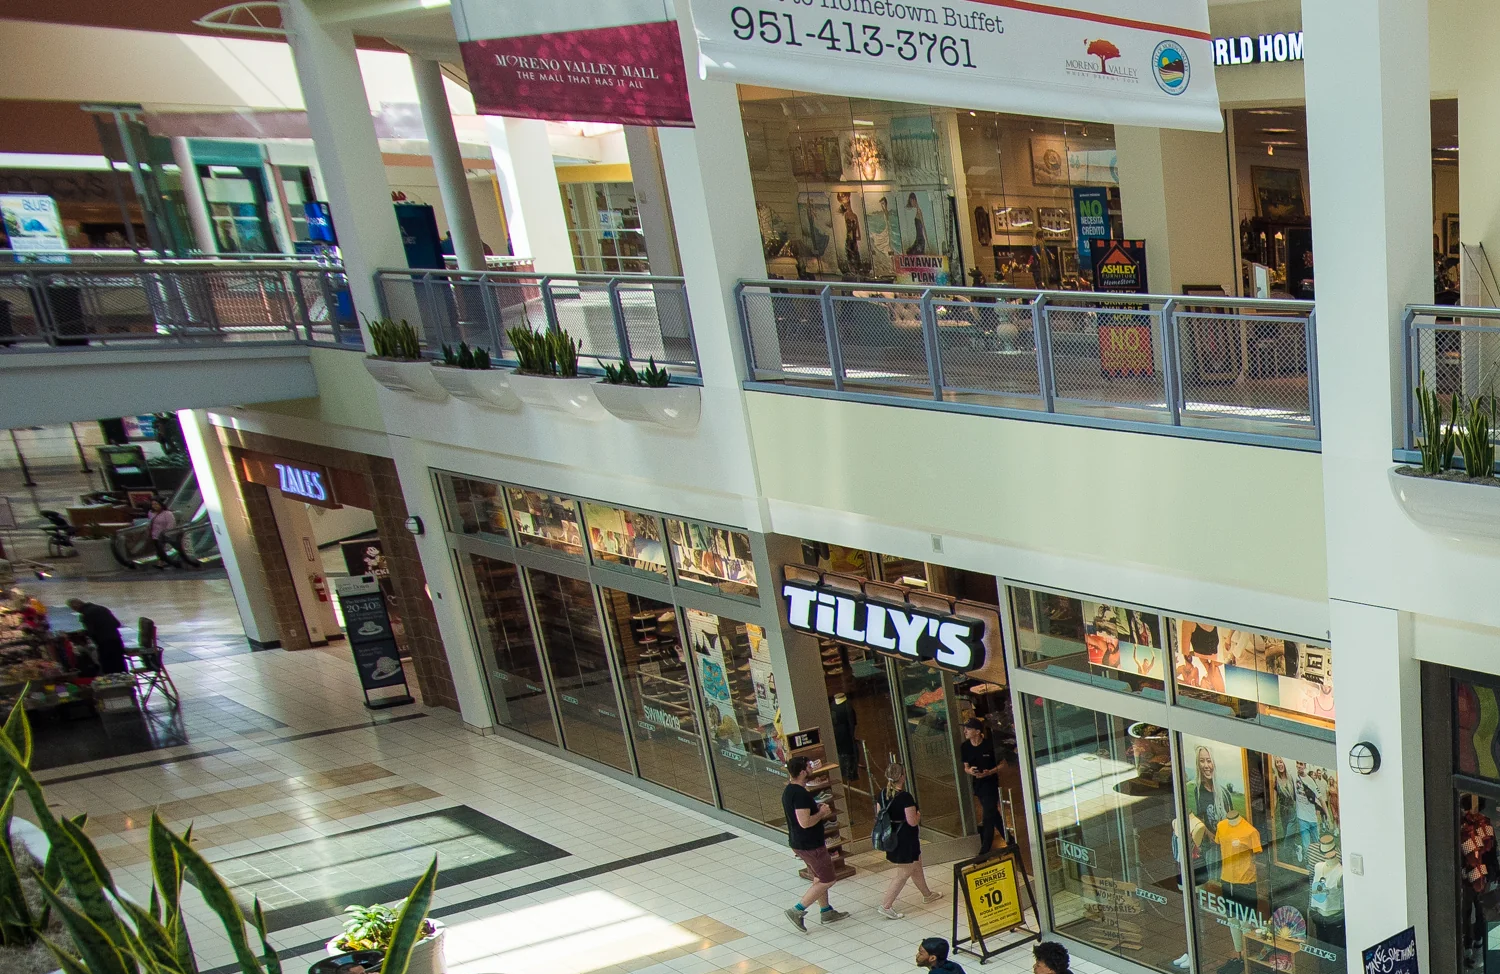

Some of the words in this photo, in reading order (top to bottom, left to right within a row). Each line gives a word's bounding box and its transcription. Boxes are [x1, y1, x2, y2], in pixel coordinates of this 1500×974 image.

[941, 6, 1004, 34] Buffet
[730, 5, 978, 69] 951-413-3761
[1211, 36, 1253, 65] RLD
[563, 60, 617, 76] VALLEY
[621, 65, 659, 79] MALL
[1065, 60, 1099, 71] MORENO
[1109, 65, 1138, 76] VALLEY
[516, 71, 535, 80] THE
[539, 73, 564, 83] MALL
[568, 75, 590, 84] THAT
[595, 78, 613, 86] HAS
[617, 79, 625, 87] IT
[1080, 200, 1103, 216] NO
[1081, 216, 1104, 225] NECESITA
[900, 257, 943, 268] LAYAWAY
[1101, 265, 1136, 274] ASHLEY
[911, 272, 935, 282] PLAN
[274, 464, 327, 500] ZALES
[1062, 842, 1090, 862] KIDS
[975, 870, 1006, 888] REWARDS
[980, 889, 1003, 908] $10
[1199, 889, 1267, 931] FESTIVAL
